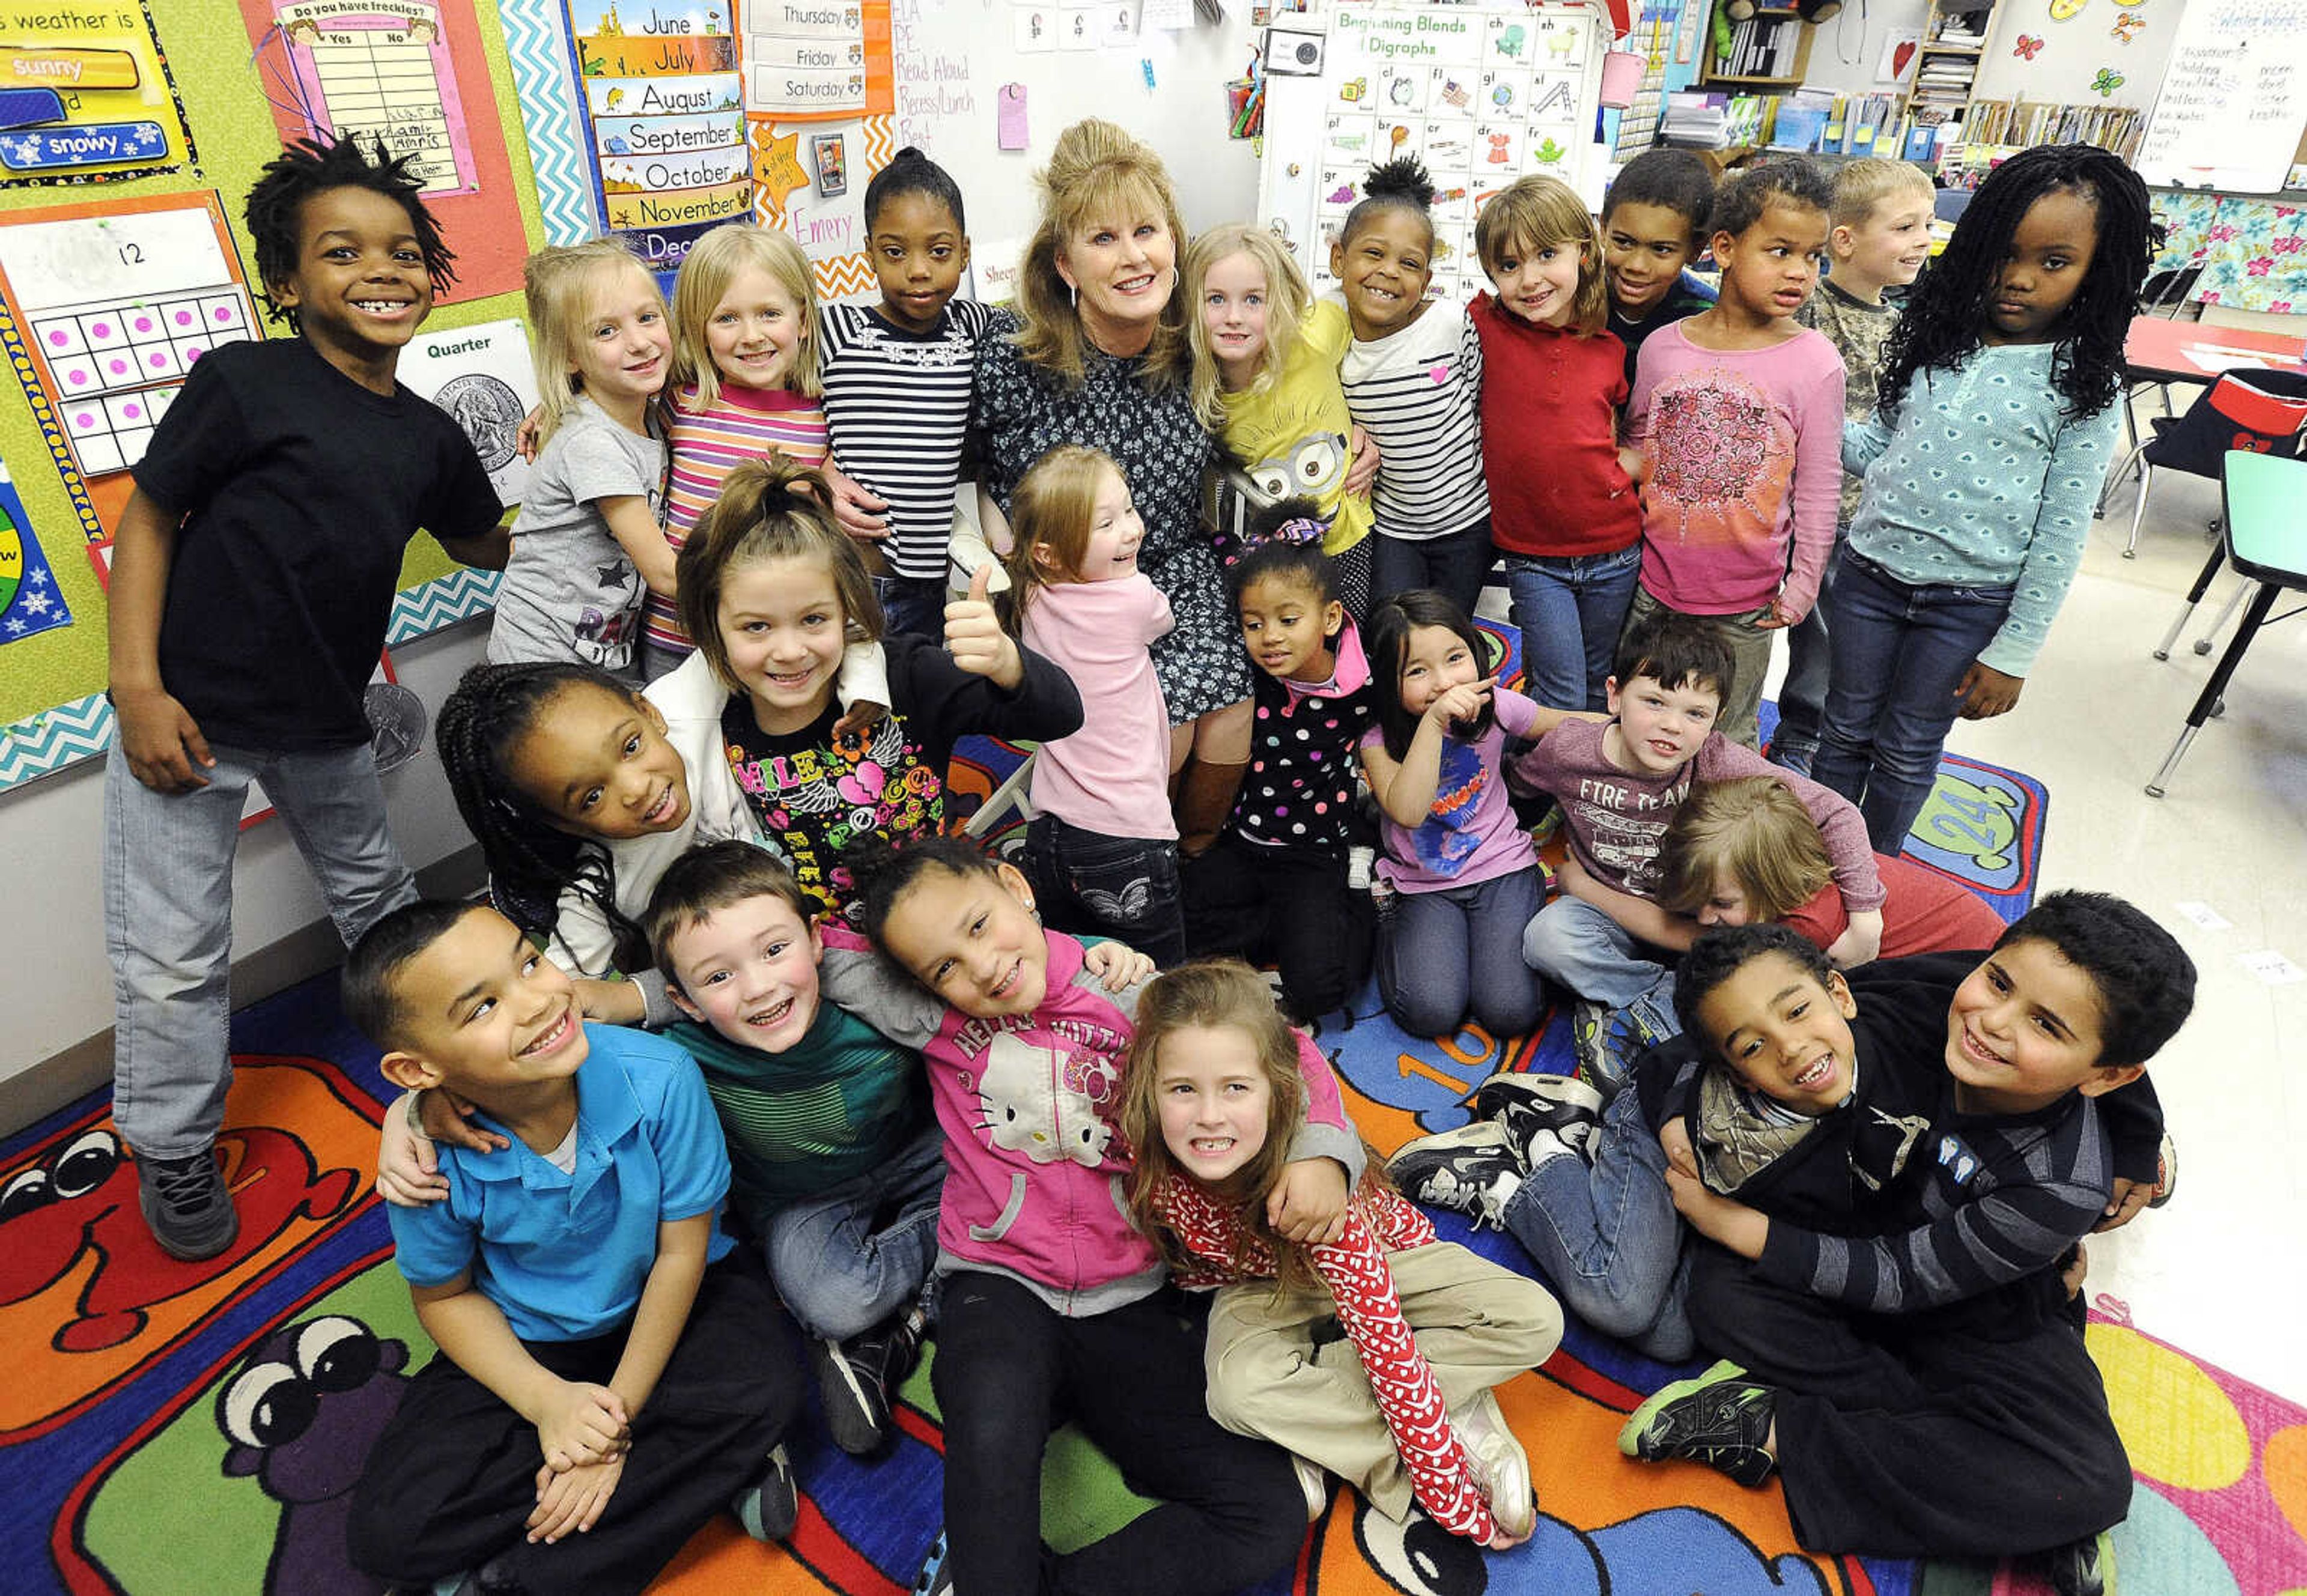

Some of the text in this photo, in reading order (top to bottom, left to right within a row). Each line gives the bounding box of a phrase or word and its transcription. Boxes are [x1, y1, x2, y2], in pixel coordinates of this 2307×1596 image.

[294, 8, 312, 18] Do
[314, 4, 338, 16] you
[338, 2, 369, 12] have
[785, 5, 842, 25] Thursday
[14, 11, 106, 29] weather
[117, 13, 133, 29] is
[643, 8, 690, 36] June
[1417, 16, 1467, 33] Blends
[1489, 17, 1503, 28] ch
[330, 34, 352, 44] Yes
[388, 34, 404, 43] No
[1369, 37, 1436, 58] Digraphs
[654, 44, 695, 71] July
[797, 49, 836, 66] Friday
[12, 58, 82, 82] sunny
[1382, 66, 1393, 77] cl
[1483, 71, 1495, 86] gl
[786, 80, 844, 98] Saturday
[641, 85, 712, 115] August
[1328, 117, 1340, 130] pl
[1378, 120, 1391, 130] br
[1427, 125, 1440, 133] cr
[1477, 125, 1492, 136] dr
[48, 135, 118, 154] snowy
[630, 124, 734, 153] September
[646, 162, 731, 189] October
[1325, 171, 1337, 183] gr
[640, 192, 735, 223] November
[794, 207, 853, 246] Emery
[119, 243, 145, 265] 12
[427, 338, 491, 358] Quarter
[1580, 778, 1628, 810] FIRE
[1930, 790, 2002, 849] 24
